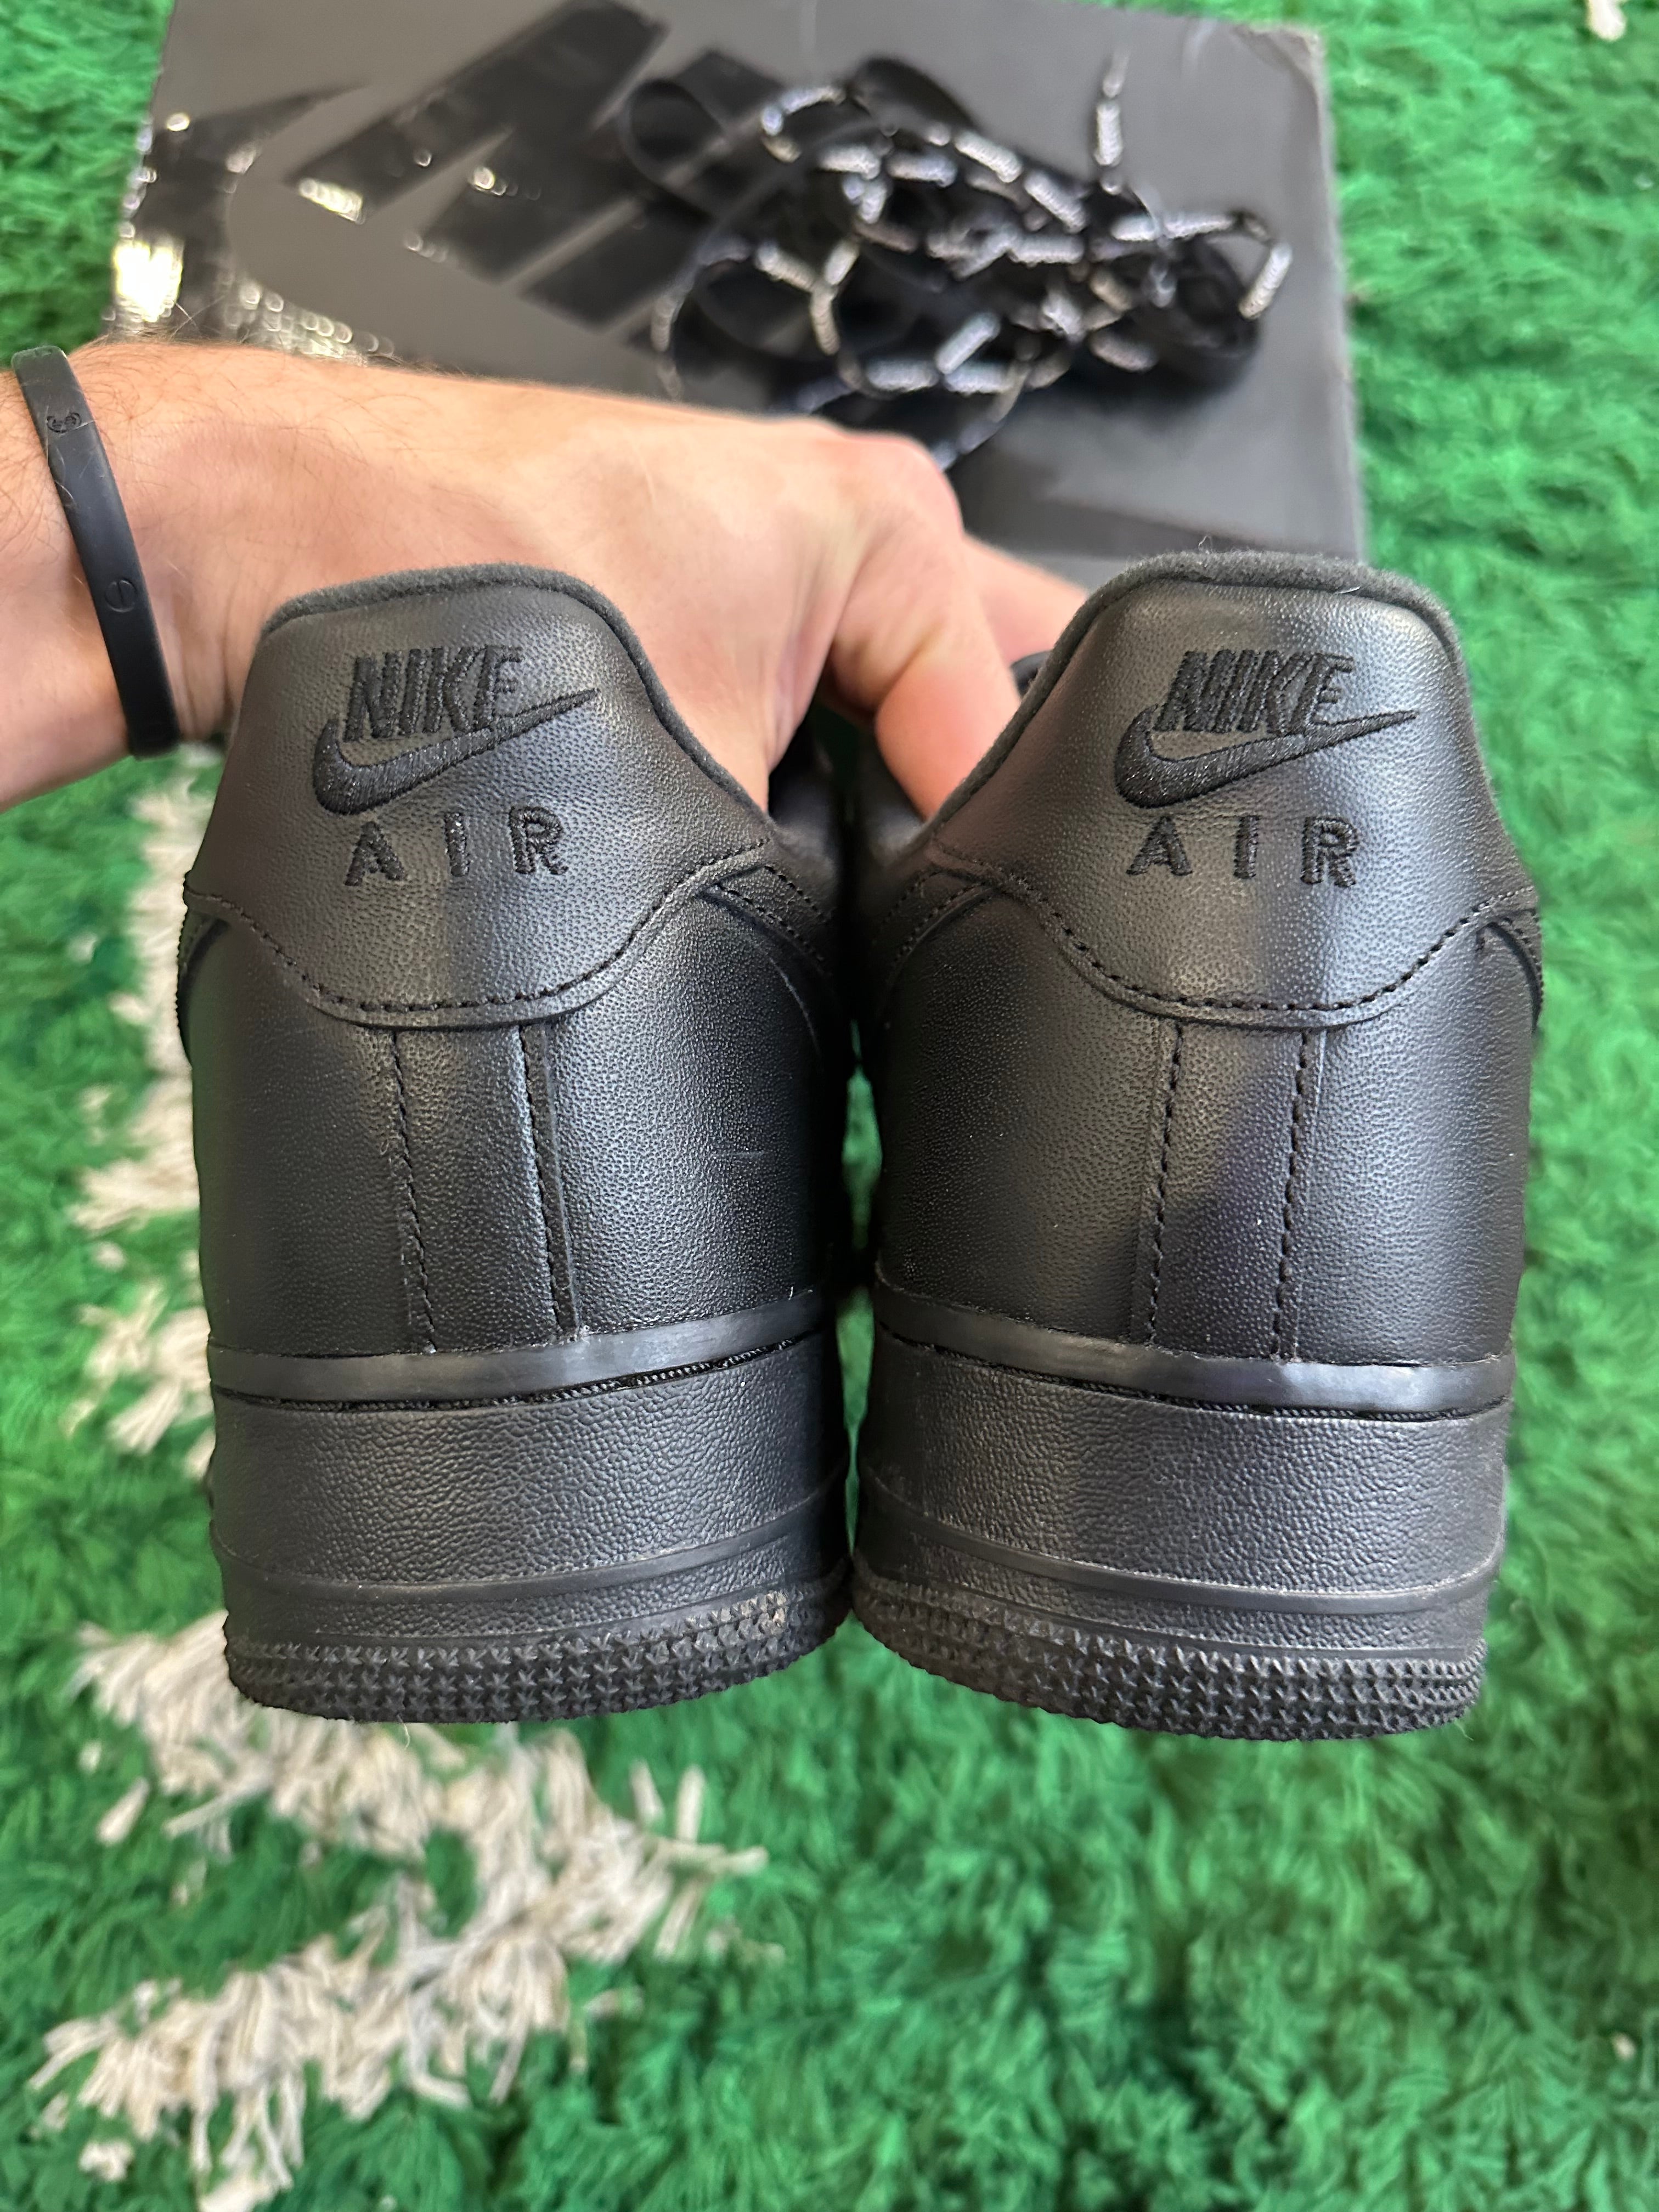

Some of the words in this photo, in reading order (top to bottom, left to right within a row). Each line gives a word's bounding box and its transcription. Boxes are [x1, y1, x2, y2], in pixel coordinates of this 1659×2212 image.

[343, 644, 524, 742] NIKE
[1153, 648, 1355, 736] NIKE
[343, 805, 569, 887] AIR
[1125, 815, 1361, 888] AIR
